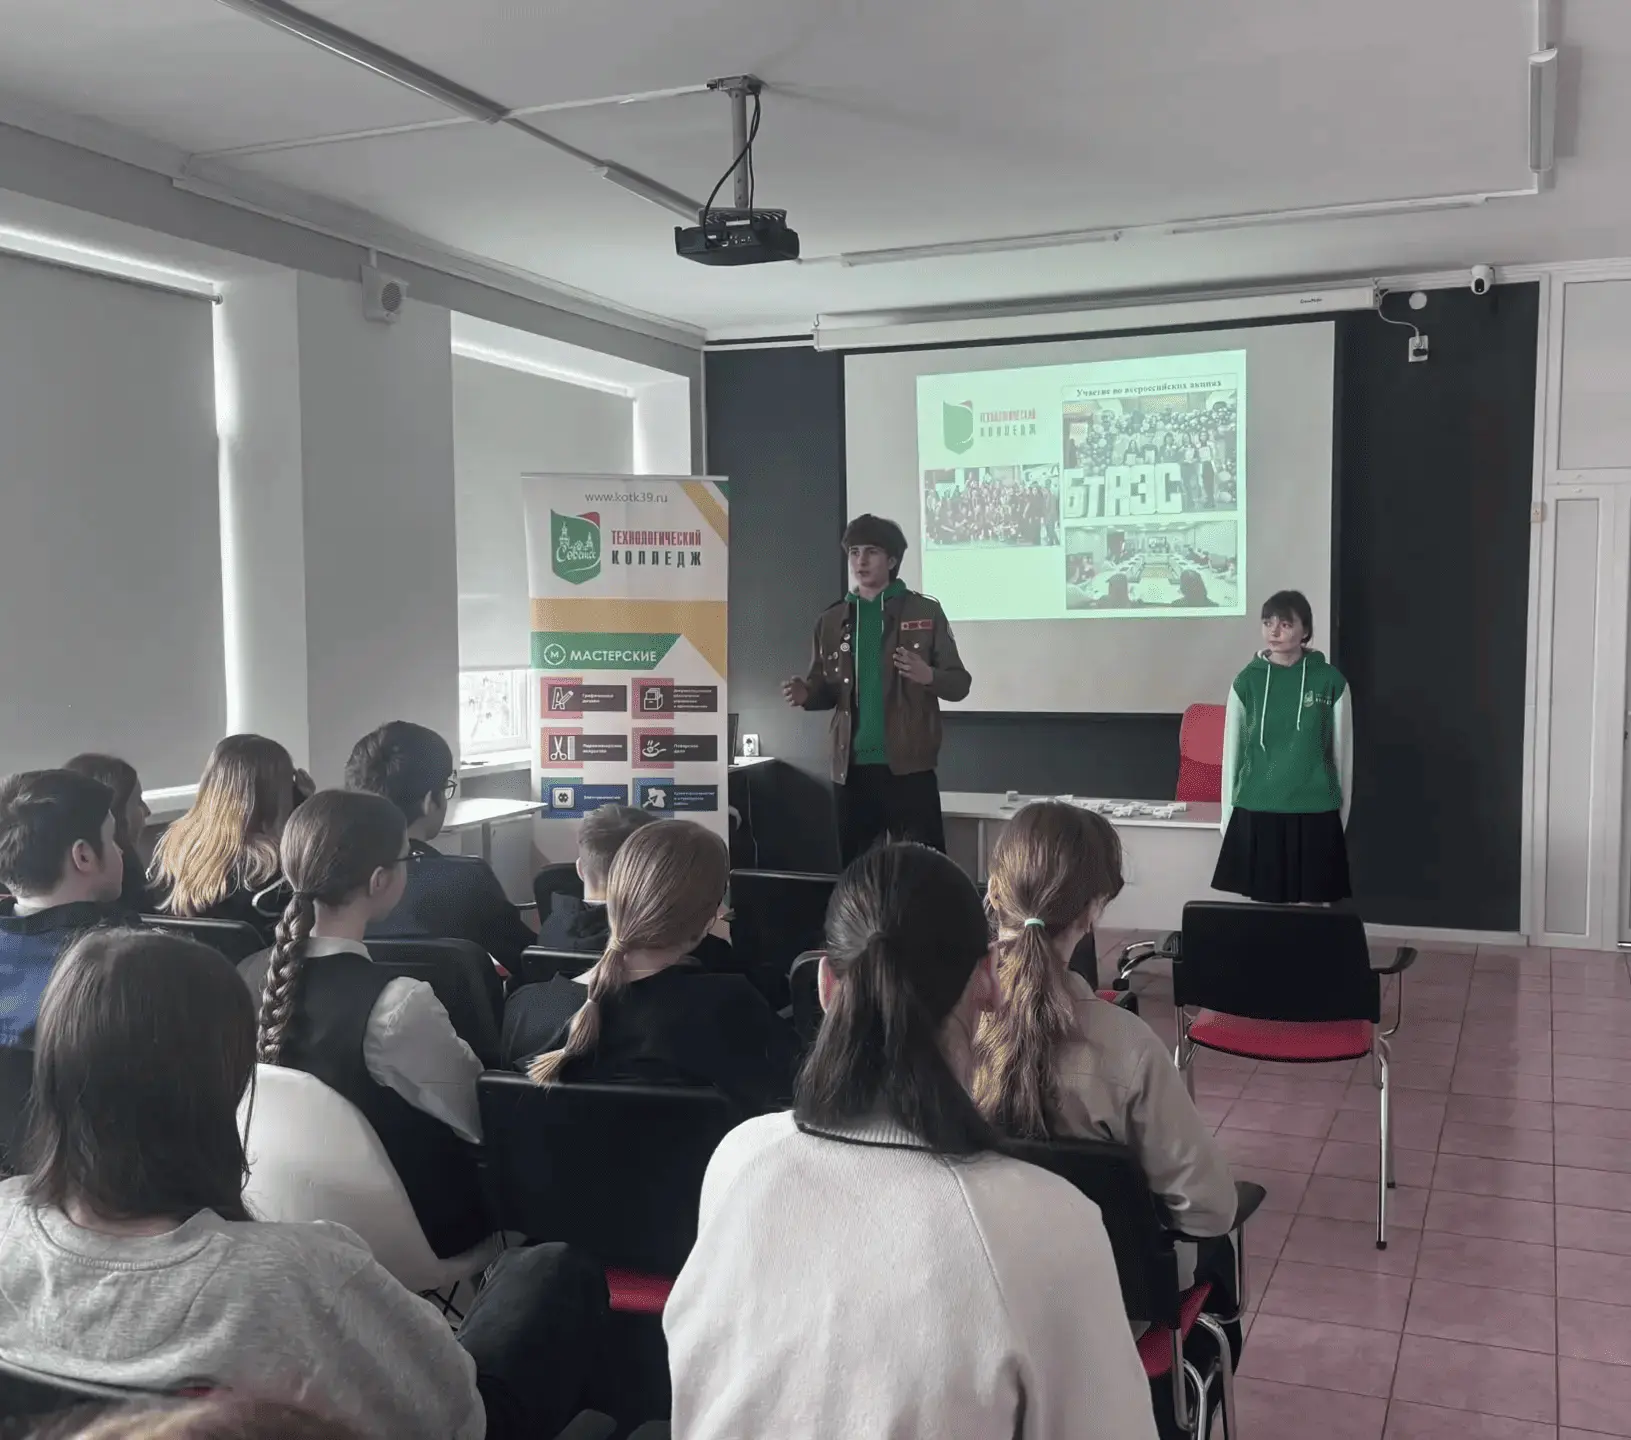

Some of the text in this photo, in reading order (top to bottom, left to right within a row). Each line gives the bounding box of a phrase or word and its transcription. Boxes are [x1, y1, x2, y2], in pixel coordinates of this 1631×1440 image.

[584, 491, 669, 503] www.kotk39.ru
[611, 529, 702, 546] ТЕХНОЛОГИЧЕСКИЙ
[611, 550, 702, 568] КОЛЛЕДЖ
[570, 649, 657, 662] МАСТЕРСКИЕ
